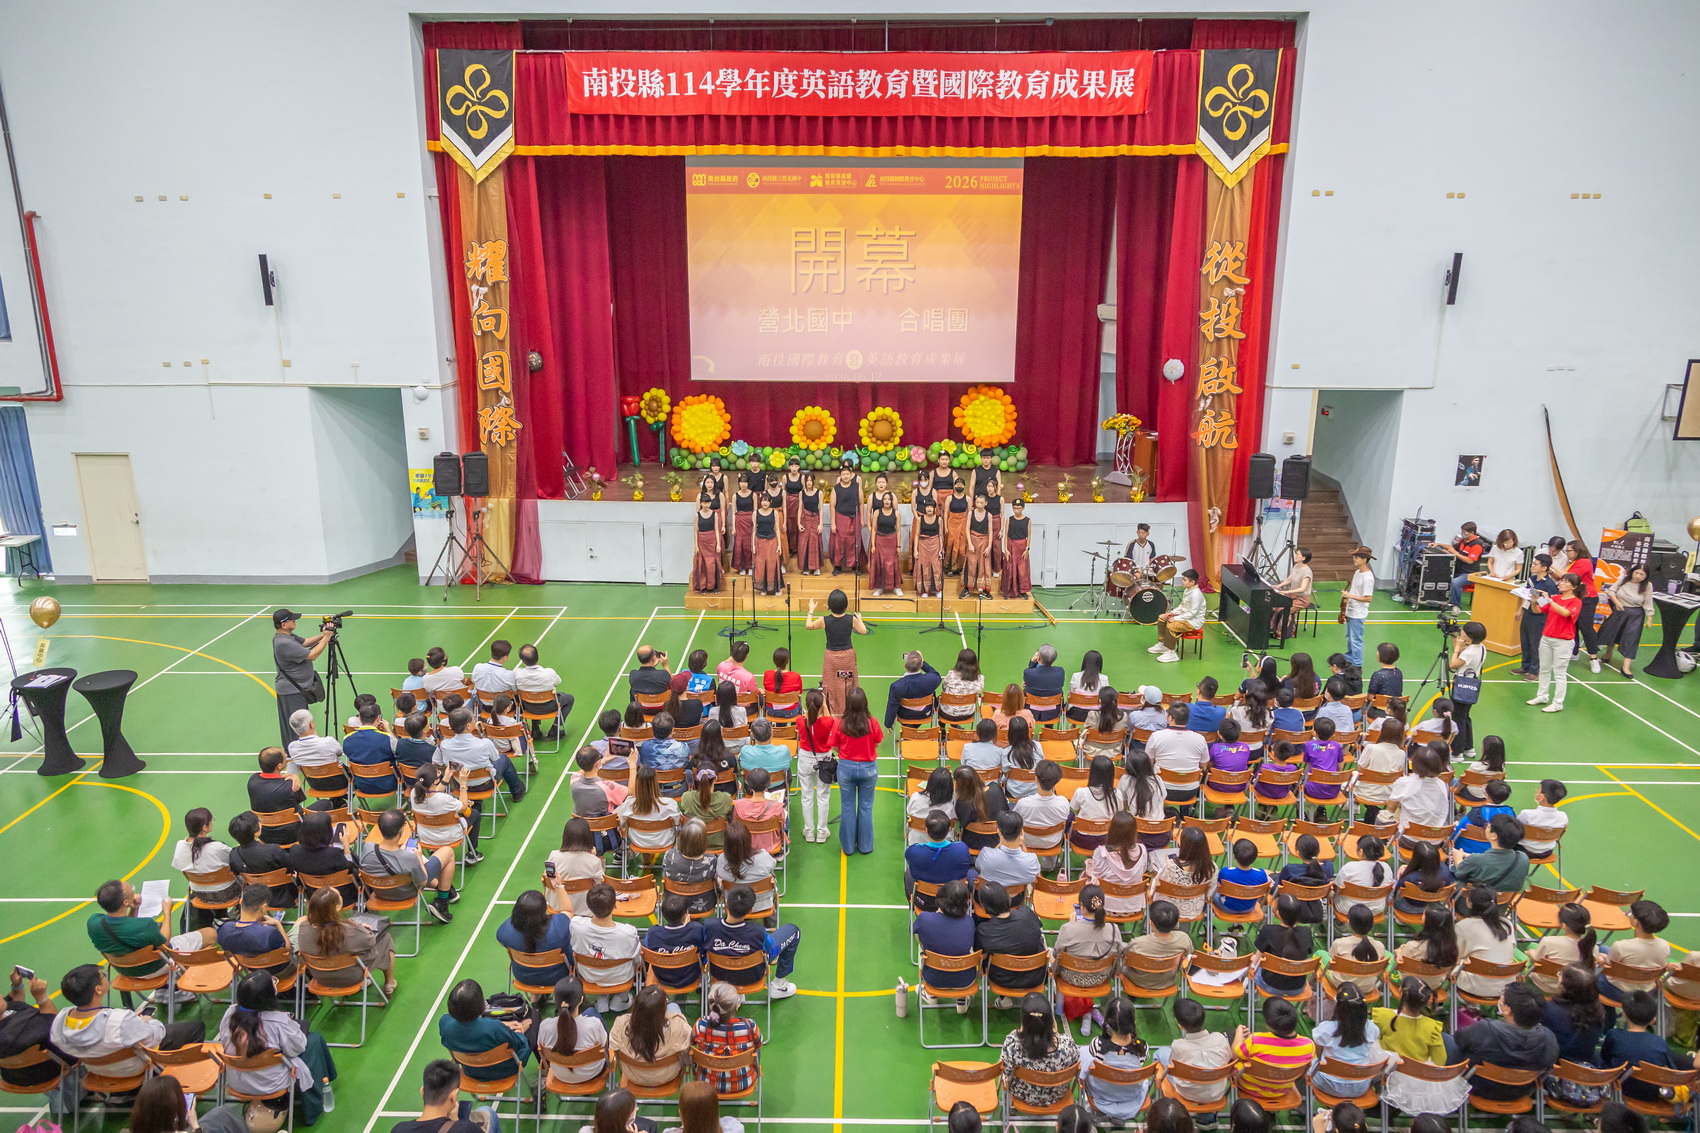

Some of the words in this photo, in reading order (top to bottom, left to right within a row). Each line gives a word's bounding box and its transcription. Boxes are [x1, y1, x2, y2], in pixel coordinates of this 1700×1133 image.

[581, 67, 1136, 100] 南投縣114學年度英語教育暨國際教育成果展
[945, 175, 978, 189] 2026
[979, 182, 1020, 190] HIGHLIGHTS
[791, 226, 917, 296] 開幕
[757, 307, 854, 334] 營北國中
[899, 307, 969, 334] 合唱團
[465, 238, 521, 448] 耀向國際
[1219, 744, 1237, 754] Ping
